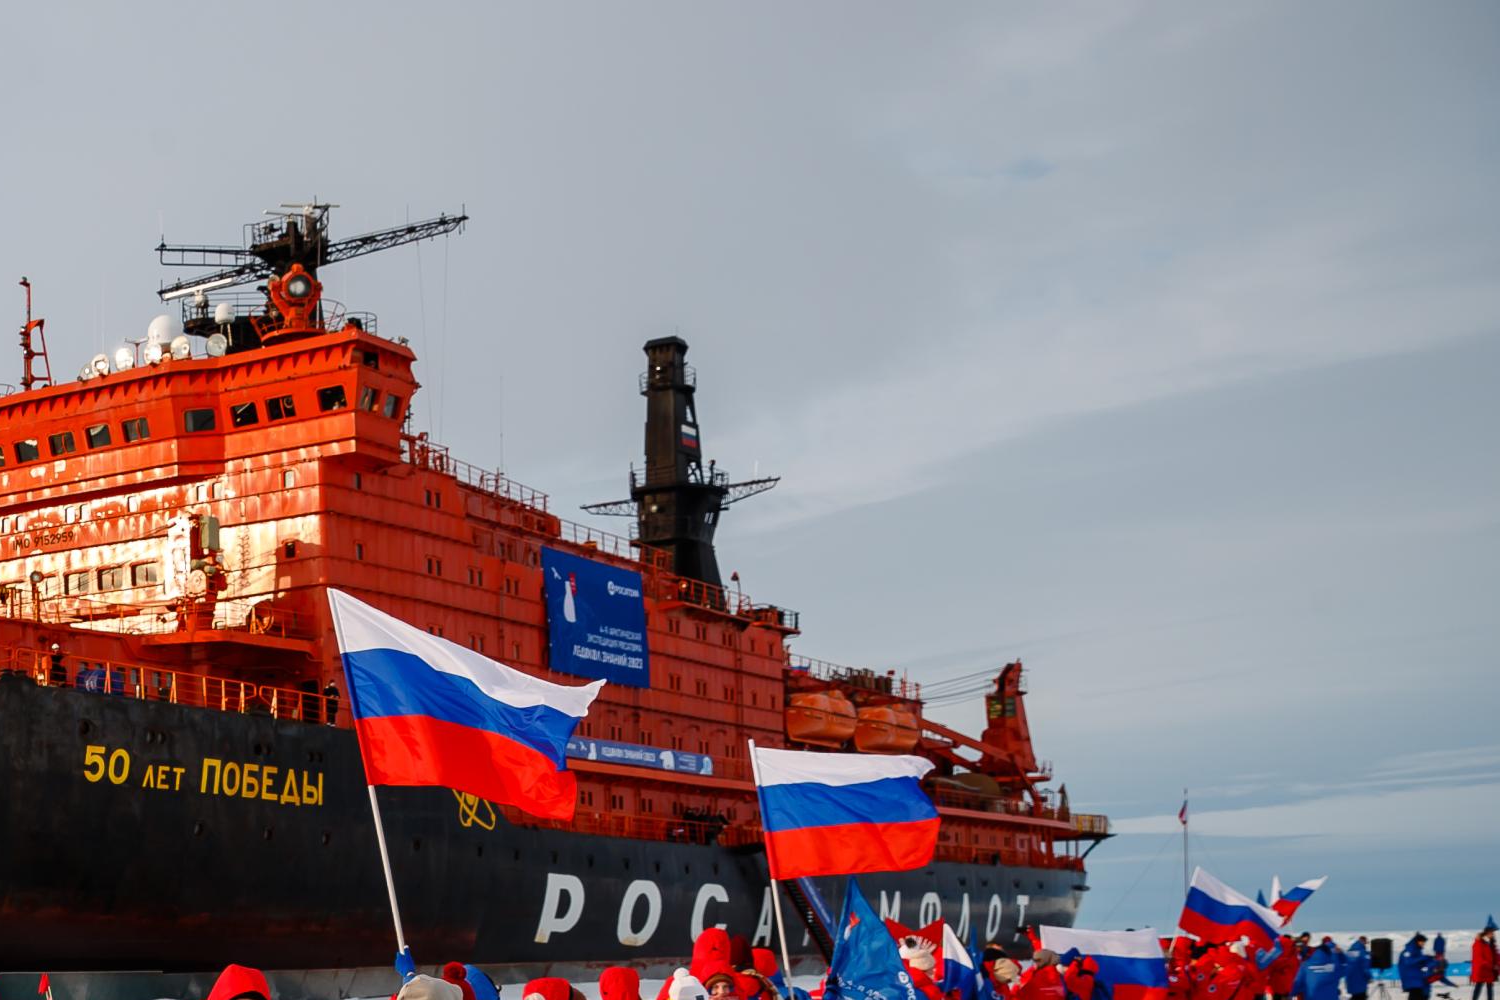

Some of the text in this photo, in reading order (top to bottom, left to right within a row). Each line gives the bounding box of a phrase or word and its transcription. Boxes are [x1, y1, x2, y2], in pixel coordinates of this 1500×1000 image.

[12, 531, 74, 551] IMO 9152959
[83, 744, 324, 806] 50 ЛЕТ ПОБЕДЫ
